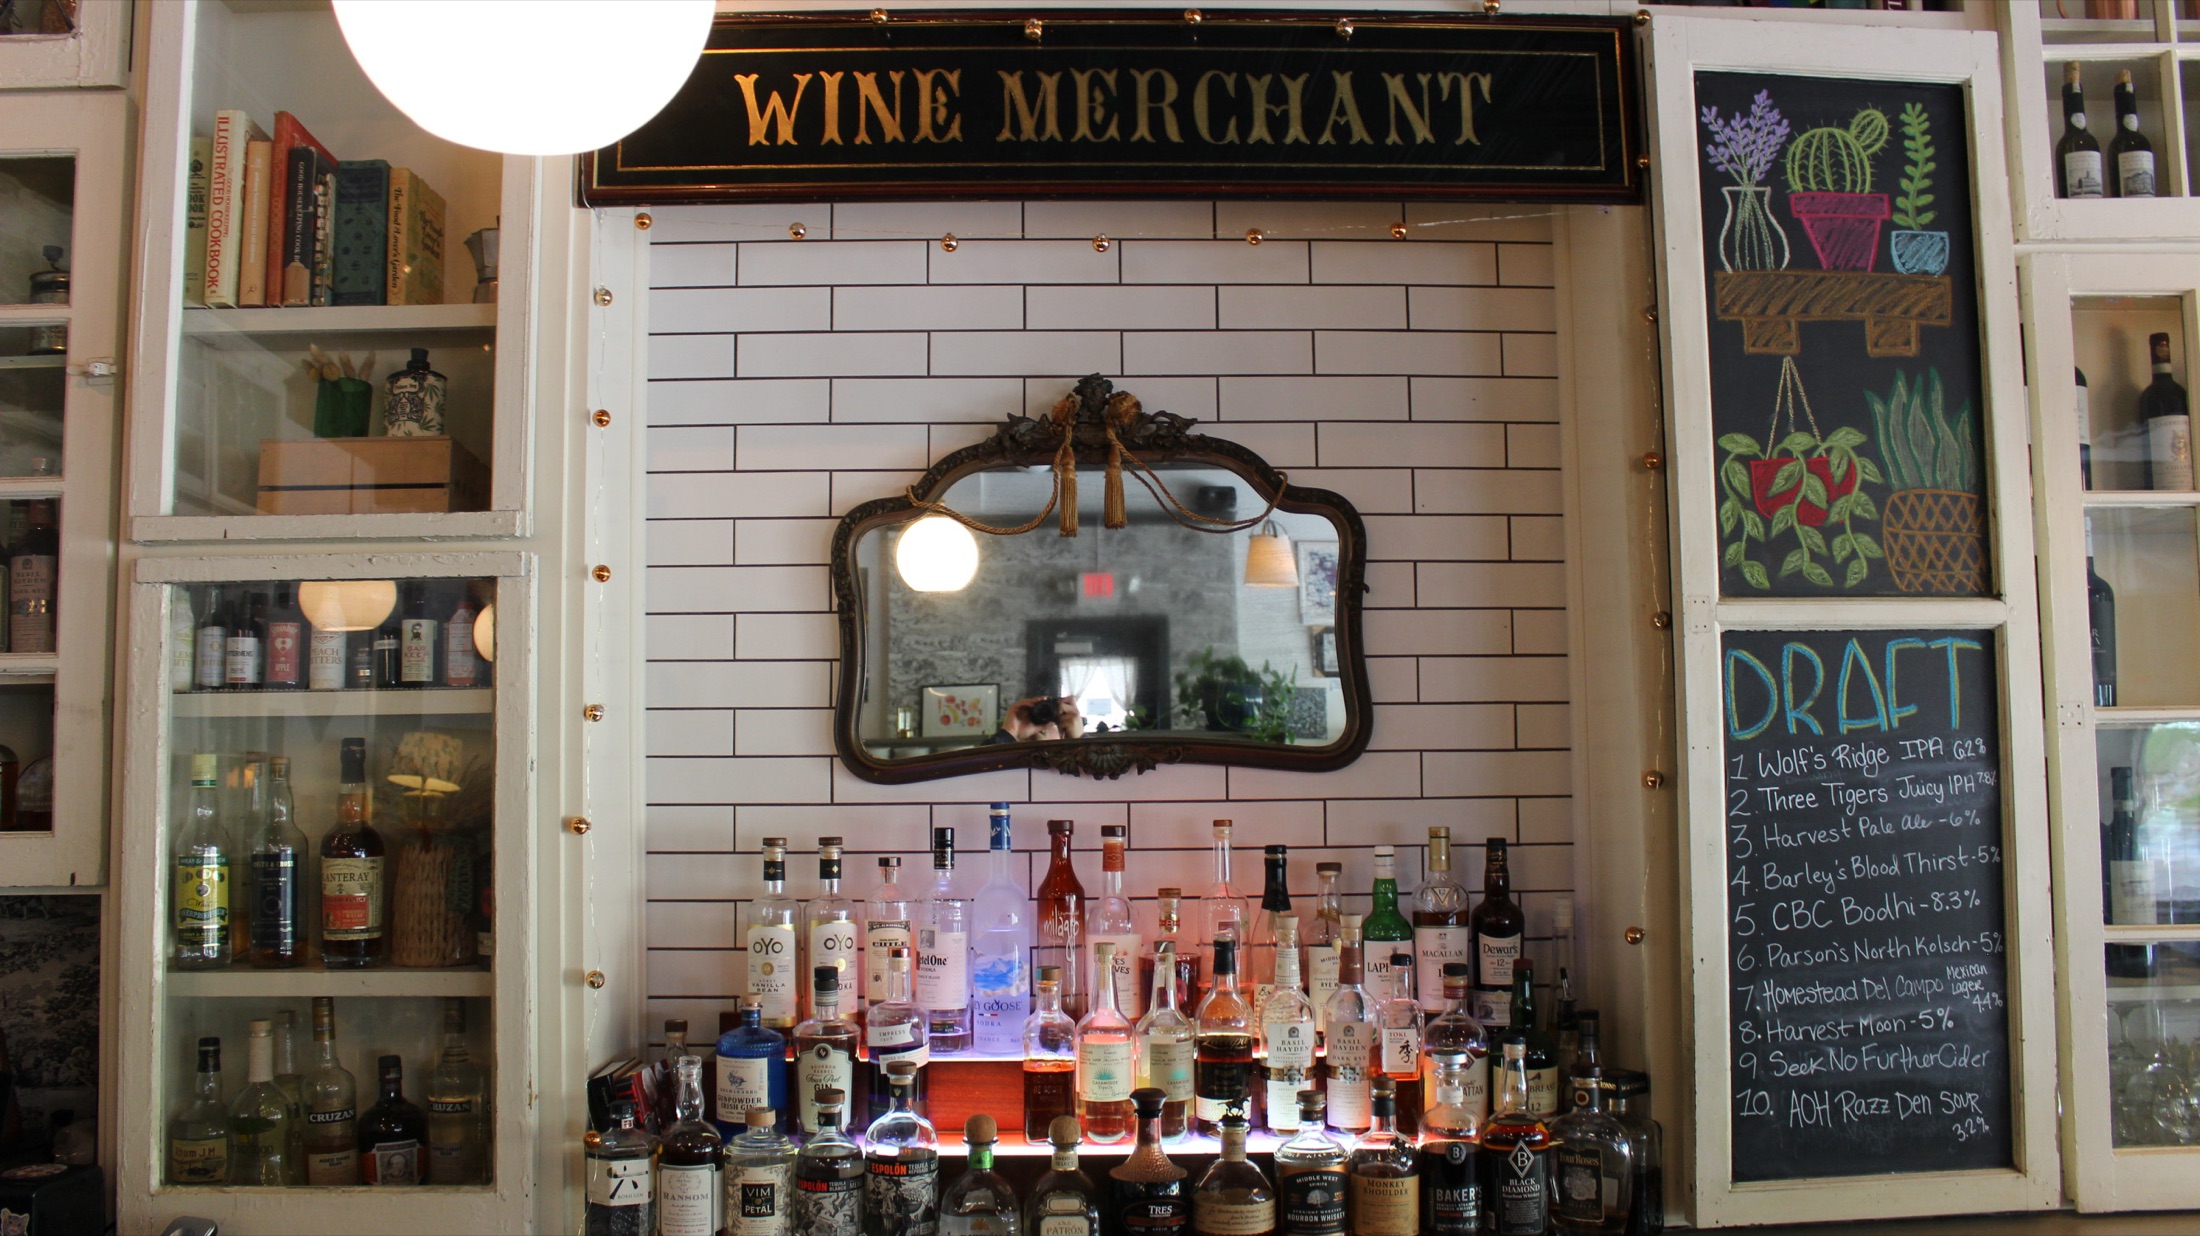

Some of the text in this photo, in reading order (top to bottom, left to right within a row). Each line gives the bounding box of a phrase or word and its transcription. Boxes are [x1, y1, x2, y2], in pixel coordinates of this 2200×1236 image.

[733, 68, 1494, 147] WINE MERCHANT
[393, 187, 403, 201] The
[207, 116, 230, 289] ILLUSTRATED COOKBOOK
[391, 259, 400, 289] Garden
[1725, 637, 1982, 740] DRAFT
[1757, 745, 1827, 778] Wolf's
[1832, 743, 1890, 778] Ridge
[1899, 737, 1943, 761] IPA
[1757, 787, 1819, 811] Three
[1821, 782, 1888, 816] Tigers
[1896, 775, 1943, 804] Juicy
[1949, 774, 1975, 796] IPA
[1763, 819, 1851, 850] Harvest
[1859, 815, 1895, 838] Pale
[1763, 860, 1847, 894] Barley's
[1851, 851, 1900, 879] Blood
[1772, 899, 1833, 931] CBC
[1422, 949, 1463, 958] MACALLAN
[1483, 943, 1519, 954] Dewar's
[1767, 942, 1849, 968] Parson's
[1854, 937, 1910, 961] North
[1496, 959, 1505, 967] 12
[1946, 964, 1988, 980] Mexican
[1763, 979, 1859, 1013] Homestead
[1862, 978, 1891, 1000] Del
[1895, 975, 1943, 1002] Campo
[984, 999, 1022, 1011] GOOSE
[1972, 991, 2003, 1013] 4.4%
[879, 1030, 906, 1038] EMPRESS
[1766, 1019, 1854, 1043] Harvest
[1769, 1051, 1827, 1077] Seek
[1829, 1047, 1857, 1071] No
[1861, 1043, 1939, 1073] Further
[1938, 1042, 1990, 1069] Cider
[717, 1094, 762, 1104] GUNPOWDER
[1531, 1103, 1541, 1112] 12
[1736, 1088, 1774, 1116] 10.
[1789, 1089, 1832, 1128] AOH
[1834, 1090, 1892, 1123] Razz
[1894, 1090, 1933, 1120] Den
[309, 1108, 355, 1122] CRUZAN
[1952, 1118, 1991, 1142] 3.2%
[1452, 1147, 1459, 1157] B
[1517, 1152, 1528, 1167] B
[1296, 1175, 1320, 1183] MIDDLE
[1367, 1180, 1405, 1188] MONKEY
[1509, 1178, 1536, 1186] BLACK
[746, 1187, 771, 1197] VIM
[1363, 1188, 1408, 1196] SHOULDER
[1436, 1186, 1482, 1202] BAKER'S
[1502, 1184, 1540, 1193] DIAMOND
[663, 1192, 709, 1201] RANSOM
[745, 1205, 772, 1213] PETAL
[1148, 1205, 1172, 1214] TRES
[1287, 1211, 1345, 1222] BOURBON WHISKEY
